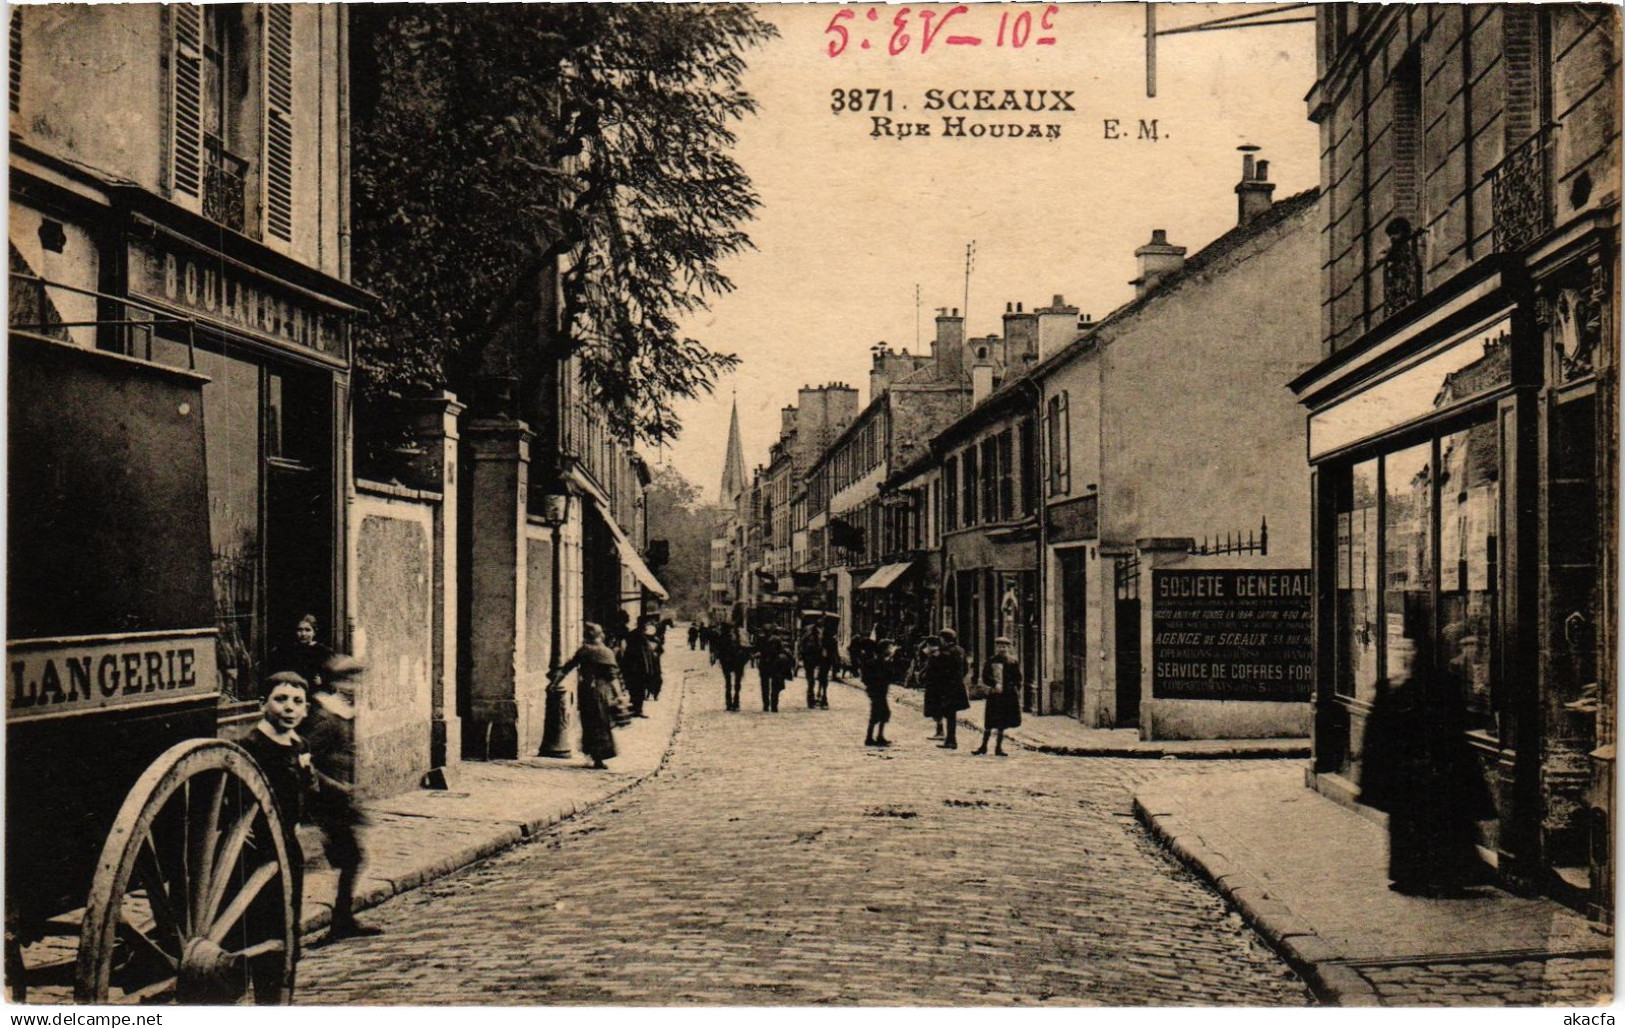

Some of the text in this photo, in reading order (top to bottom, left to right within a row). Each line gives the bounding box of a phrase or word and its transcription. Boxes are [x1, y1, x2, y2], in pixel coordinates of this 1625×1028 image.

[165, 252, 325, 351] BOULANGERIE
[1155, 632, 1202, 645] AGENCE
[1217, 633, 1268, 646] SCEAUX
[1157, 662, 1209, 678] SERVICE
[1211, 663, 1227, 679] DE
[1231, 664, 1283, 680] COFFRES
